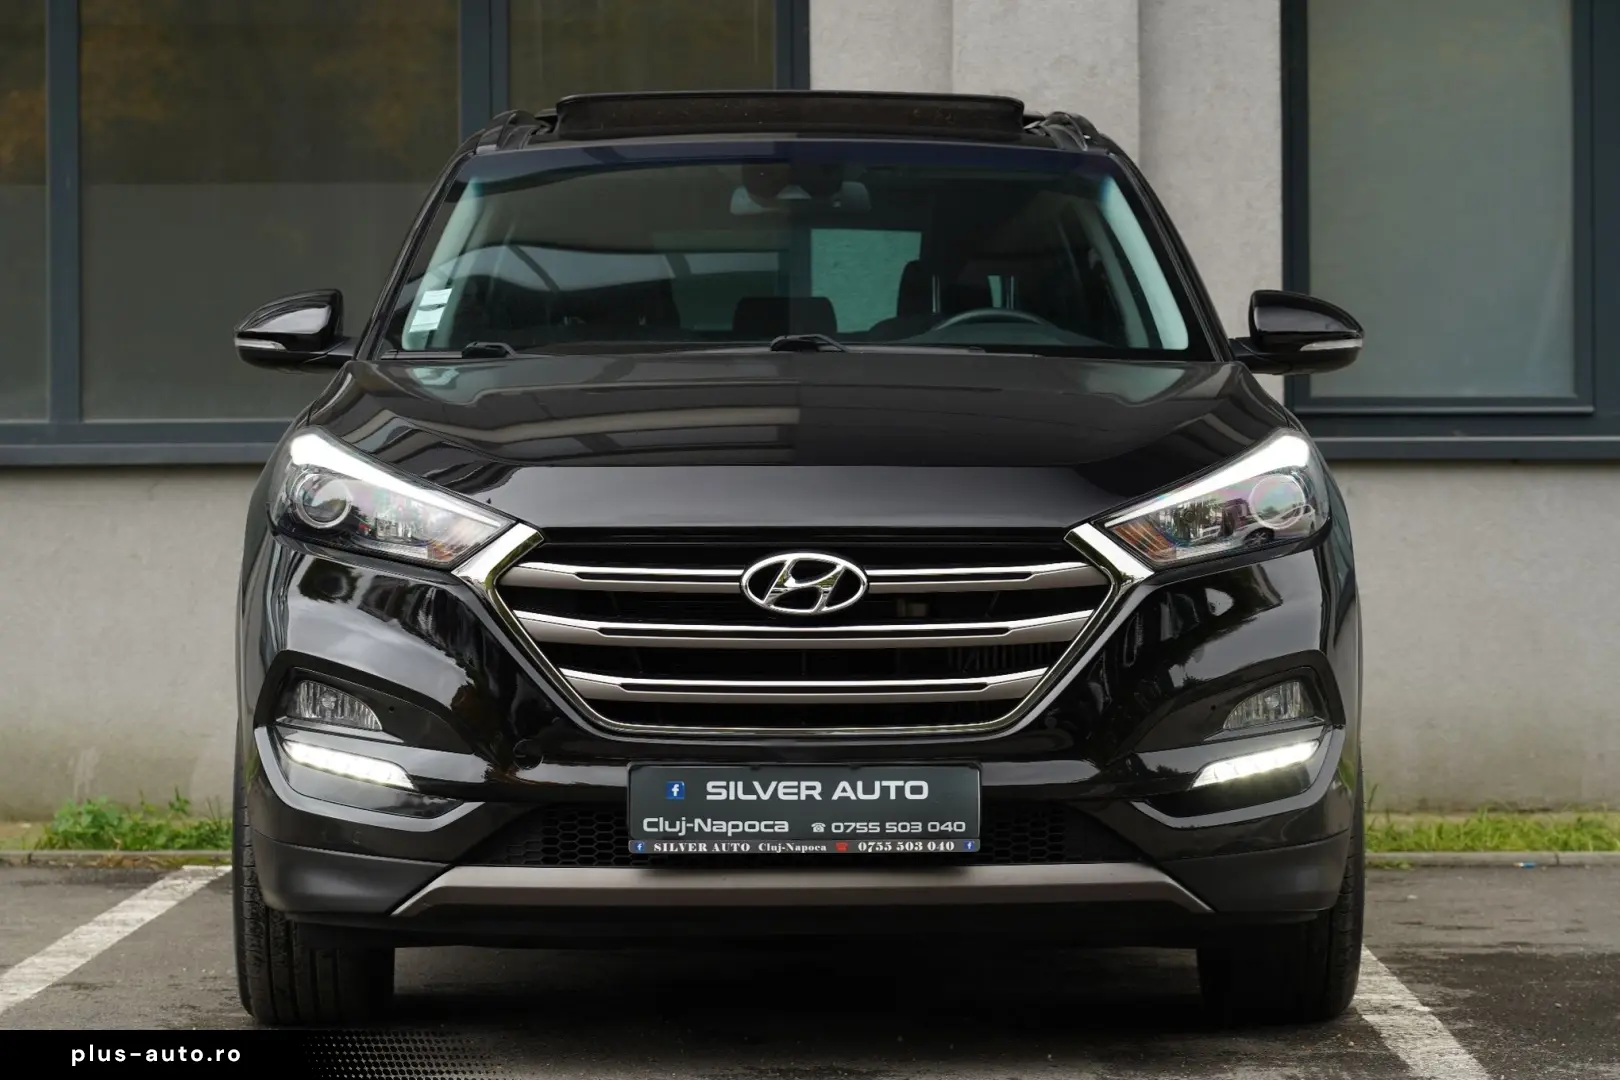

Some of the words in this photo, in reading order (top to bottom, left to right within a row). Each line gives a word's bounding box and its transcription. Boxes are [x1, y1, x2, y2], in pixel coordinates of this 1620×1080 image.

[706, 780, 823, 801] SILVER
[832, 780, 929, 801] AUTO
[642, 816, 790, 837] Cluj-Napoca
[831, 821, 881, 833] 0755
[885, 821, 923, 833] 503
[927, 821, 966, 833] 040
[653, 842, 708, 852] SILVER
[711, 842, 751, 852] AUTO
[758, 842, 827, 853] Cluj-Napoca
[858, 841, 892, 852] 0755
[896, 841, 924, 852] 503
[927, 841, 955, 852] 040
